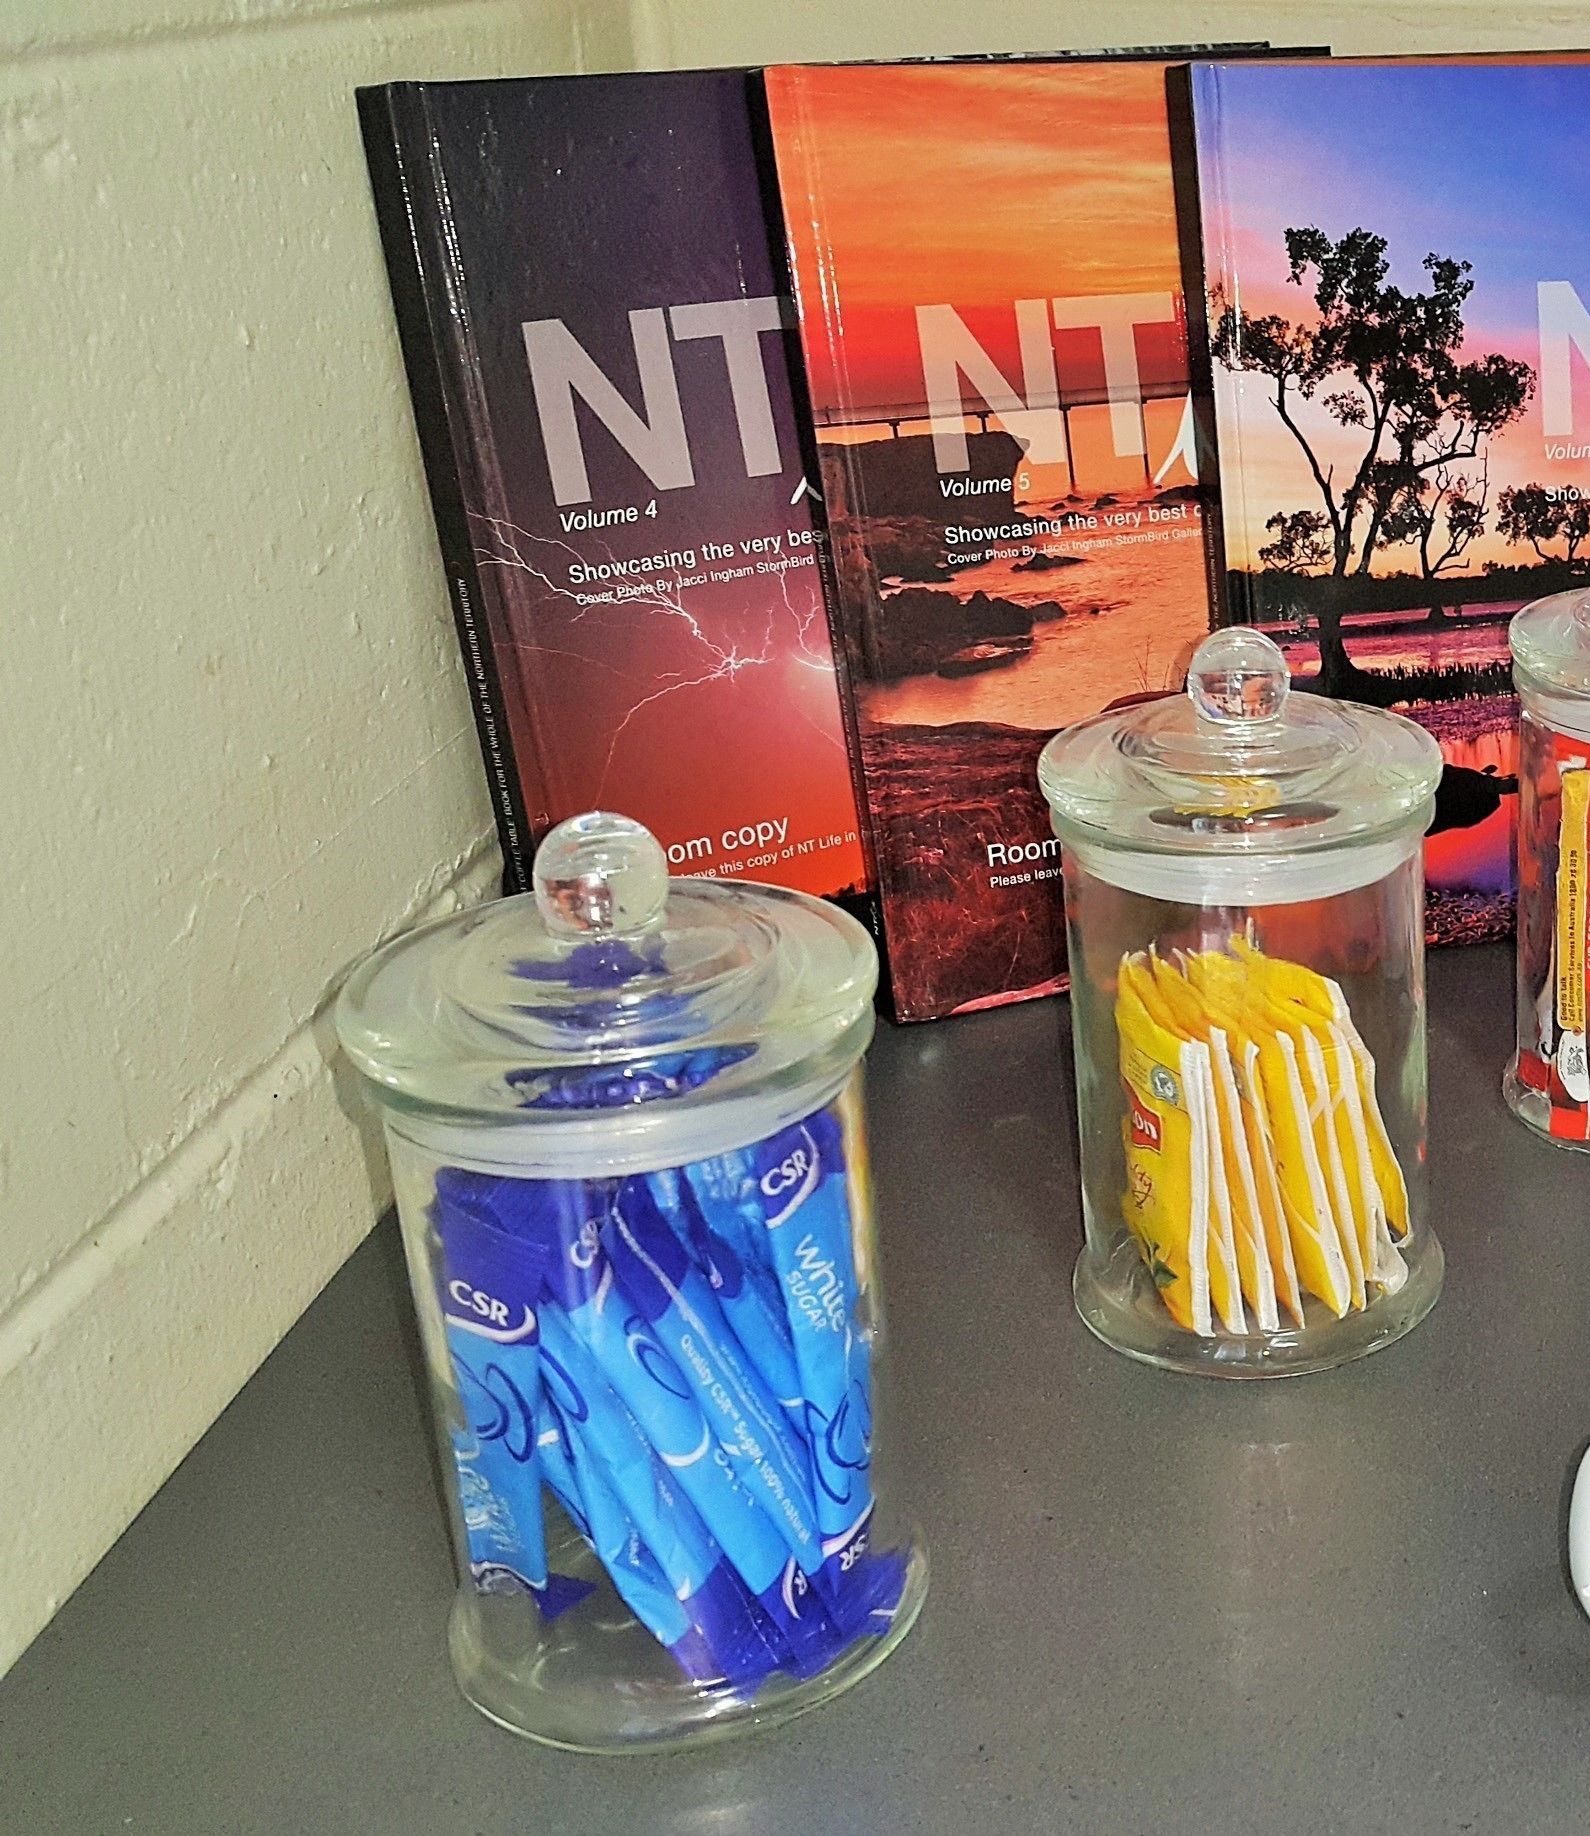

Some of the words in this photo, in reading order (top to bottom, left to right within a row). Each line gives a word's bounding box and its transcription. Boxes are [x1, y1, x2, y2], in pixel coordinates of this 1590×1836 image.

[521, 296, 783, 506] NT
[915, 291, 1175, 474] NT
[940, 477, 1012, 498] Volume
[1018, 472, 1031, 491] 5
[560, 506, 638, 532] Volume
[645, 499, 658, 518] 4
[944, 516, 1062, 545] Showcasing
[1067, 513, 1098, 531] the
[1103, 510, 1142, 529] very
[1148, 503, 1187, 523] best
[568, 549, 696, 584] Showcasing
[702, 540, 734, 561] the
[739, 533, 782, 555] very
[948, 552, 982, 565] Cover
[985, 547, 1019, 561] Photo
[1022, 545, 1037, 559] By
[1040, 541, 1069, 556] Jacci
[1072, 537, 1113, 552] Ingham
[1115, 530, 1169, 546] StormBird
[577, 588, 614, 606] Cover
[617, 583, 653, 599] Photo
[656, 580, 674, 594] By
[677, 571, 707, 589] Jacci
[711, 566, 754, 583] Ingham
[757, 553, 815, 575] StormBird
[719, 860, 744, 874] this
[747, 851, 778, 868] copy
[781, 845, 795, 859] of
[797, 840, 816, 855] NT
[819, 835, 842, 848] Life
[845, 831, 857, 842] in
[722, 817, 788, 850] copy
[987, 838, 1063, 867] Room
[990, 873, 1031, 888] Please
[760, 1149, 809, 1196] CSR
[448, 1280, 510, 1327] CSR
[786, 1271, 827, 1331] SUGAR
